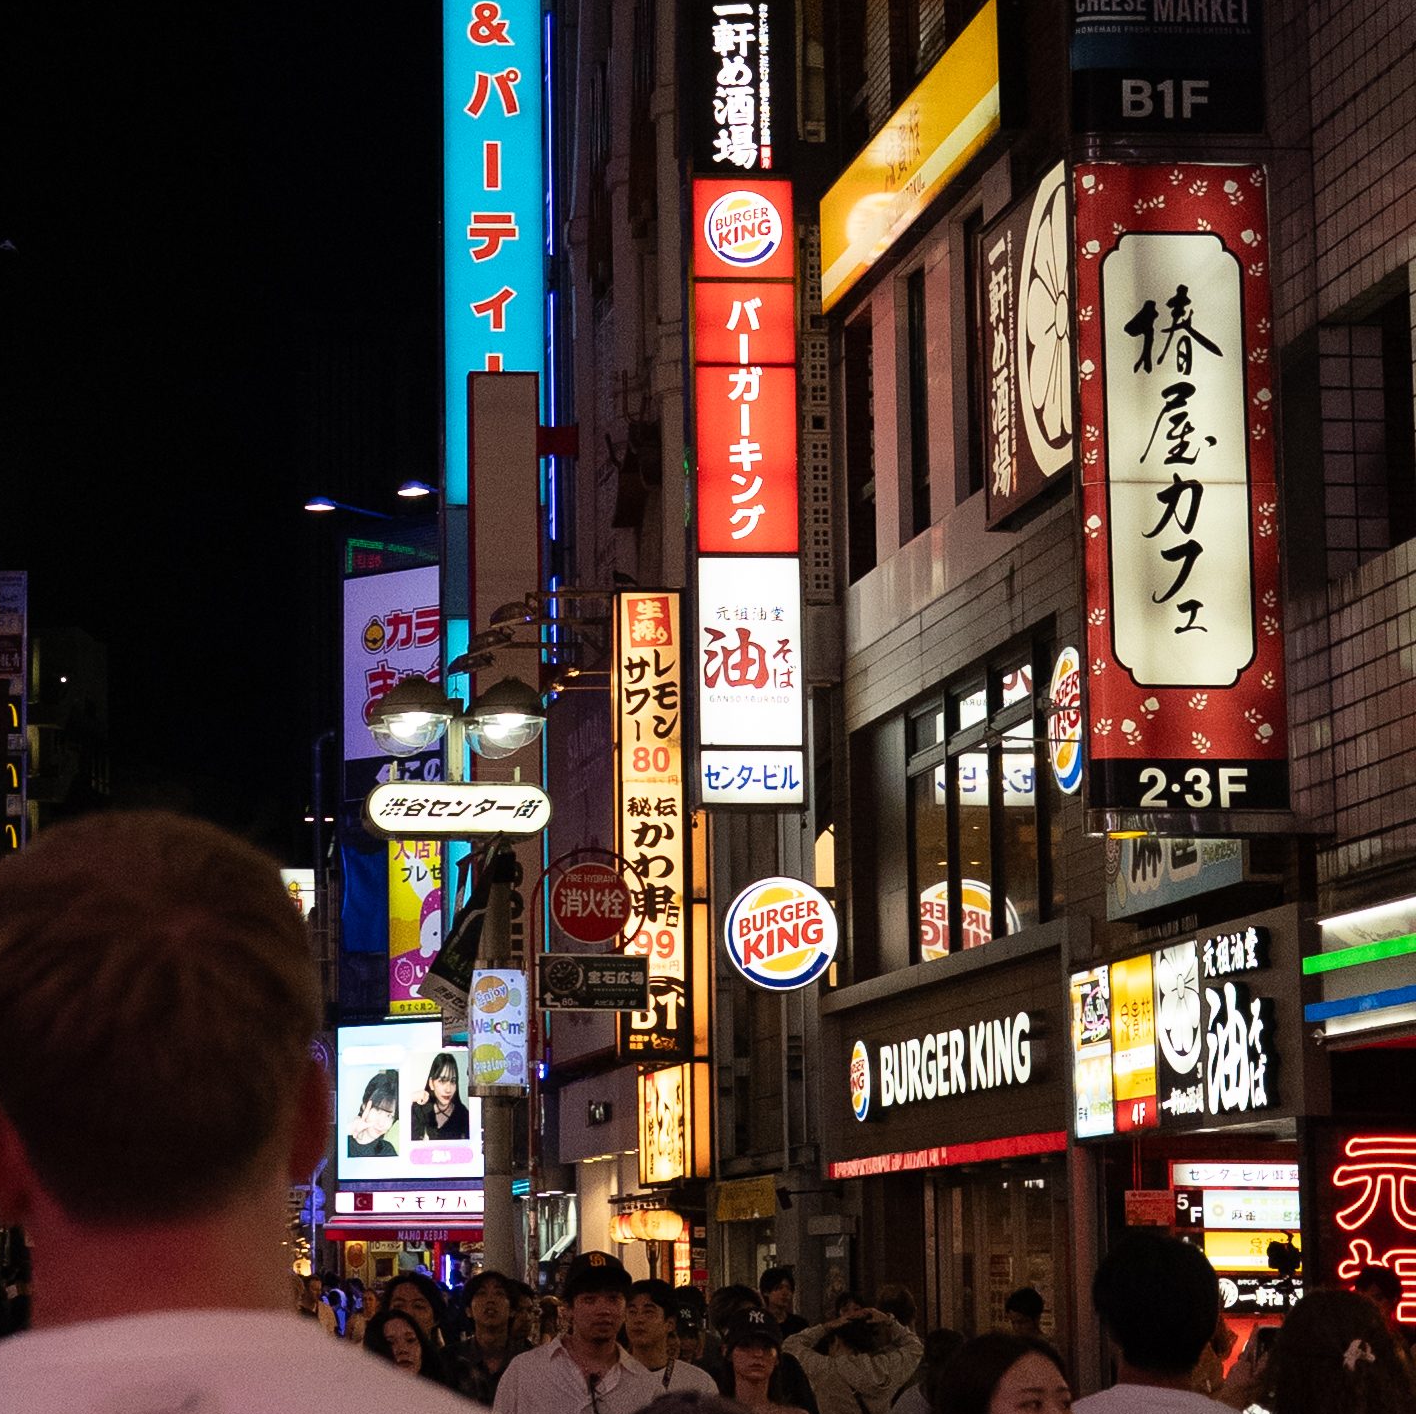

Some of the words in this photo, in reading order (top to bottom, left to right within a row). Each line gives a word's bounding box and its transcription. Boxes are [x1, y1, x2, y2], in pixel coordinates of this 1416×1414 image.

[711, 2, 760, 171] 一軒め酒場
[1121, 79, 1210, 120] B1F
[714, 207, 771, 233] BURGER
[716, 220, 774, 252] KING
[986, 227, 1013, 501] 一軒め酒場
[724, 298, 767, 541] バーガーキング
[1123, 283, 1224, 636] 椿屋カフェ
[716, 606, 786, 622] 元祖油堂
[623, 654, 651, 743] サワー
[652, 648, 680, 740] レモン
[632, 746, 671, 773] 80
[703, 764, 801, 791] センタービル
[378, 796, 542, 820] 渋谷センター街
[626, 796, 678, 818] 秘伝
[558, 888, 626, 919] 消火栓
[738, 899, 820, 939] BURGER
[743, 918, 824, 967] KING
[1202, 926, 1259, 978] 元祖油堂
[587, 970, 645, 986] 宝石広場
[474, 985, 508, 1007] Enjoy
[471, 1018, 525, 1036] Welcome
[879, 1026, 967, 1109] BURGER
[968, 1010, 1032, 1090] KING
[1204, 981, 1268, 1116] 油そば
[1131, 1102, 1147, 1125] 4F
[1176, 1193, 1204, 1224] 5F
